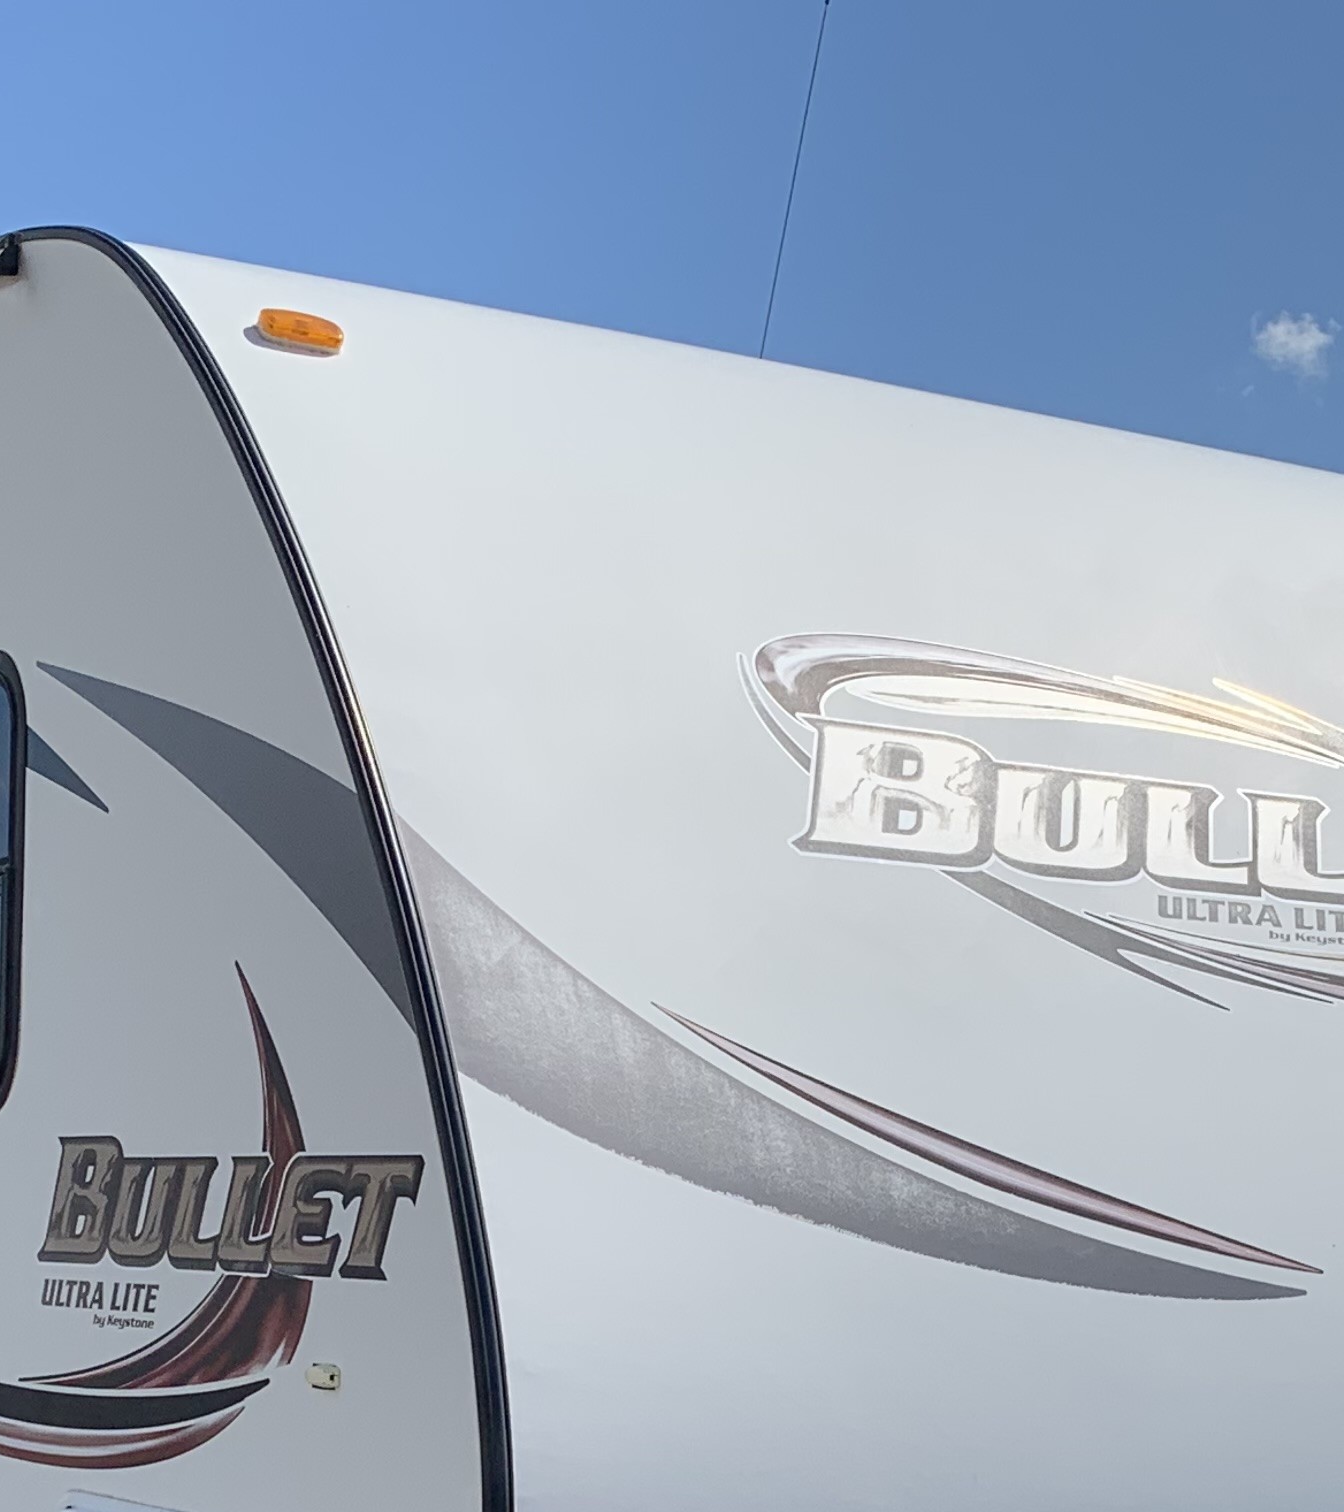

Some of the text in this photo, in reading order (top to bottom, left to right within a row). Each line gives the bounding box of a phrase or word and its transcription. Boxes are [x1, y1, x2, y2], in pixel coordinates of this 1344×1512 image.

[1157, 895, 1282, 928] ULTRA
[1269, 930, 1290, 943] by
[38, 1136, 425, 1280] BULLET
[41, 1278, 160, 1313] ULTRA LITE
[93, 1314, 155, 1330] by Keystone
